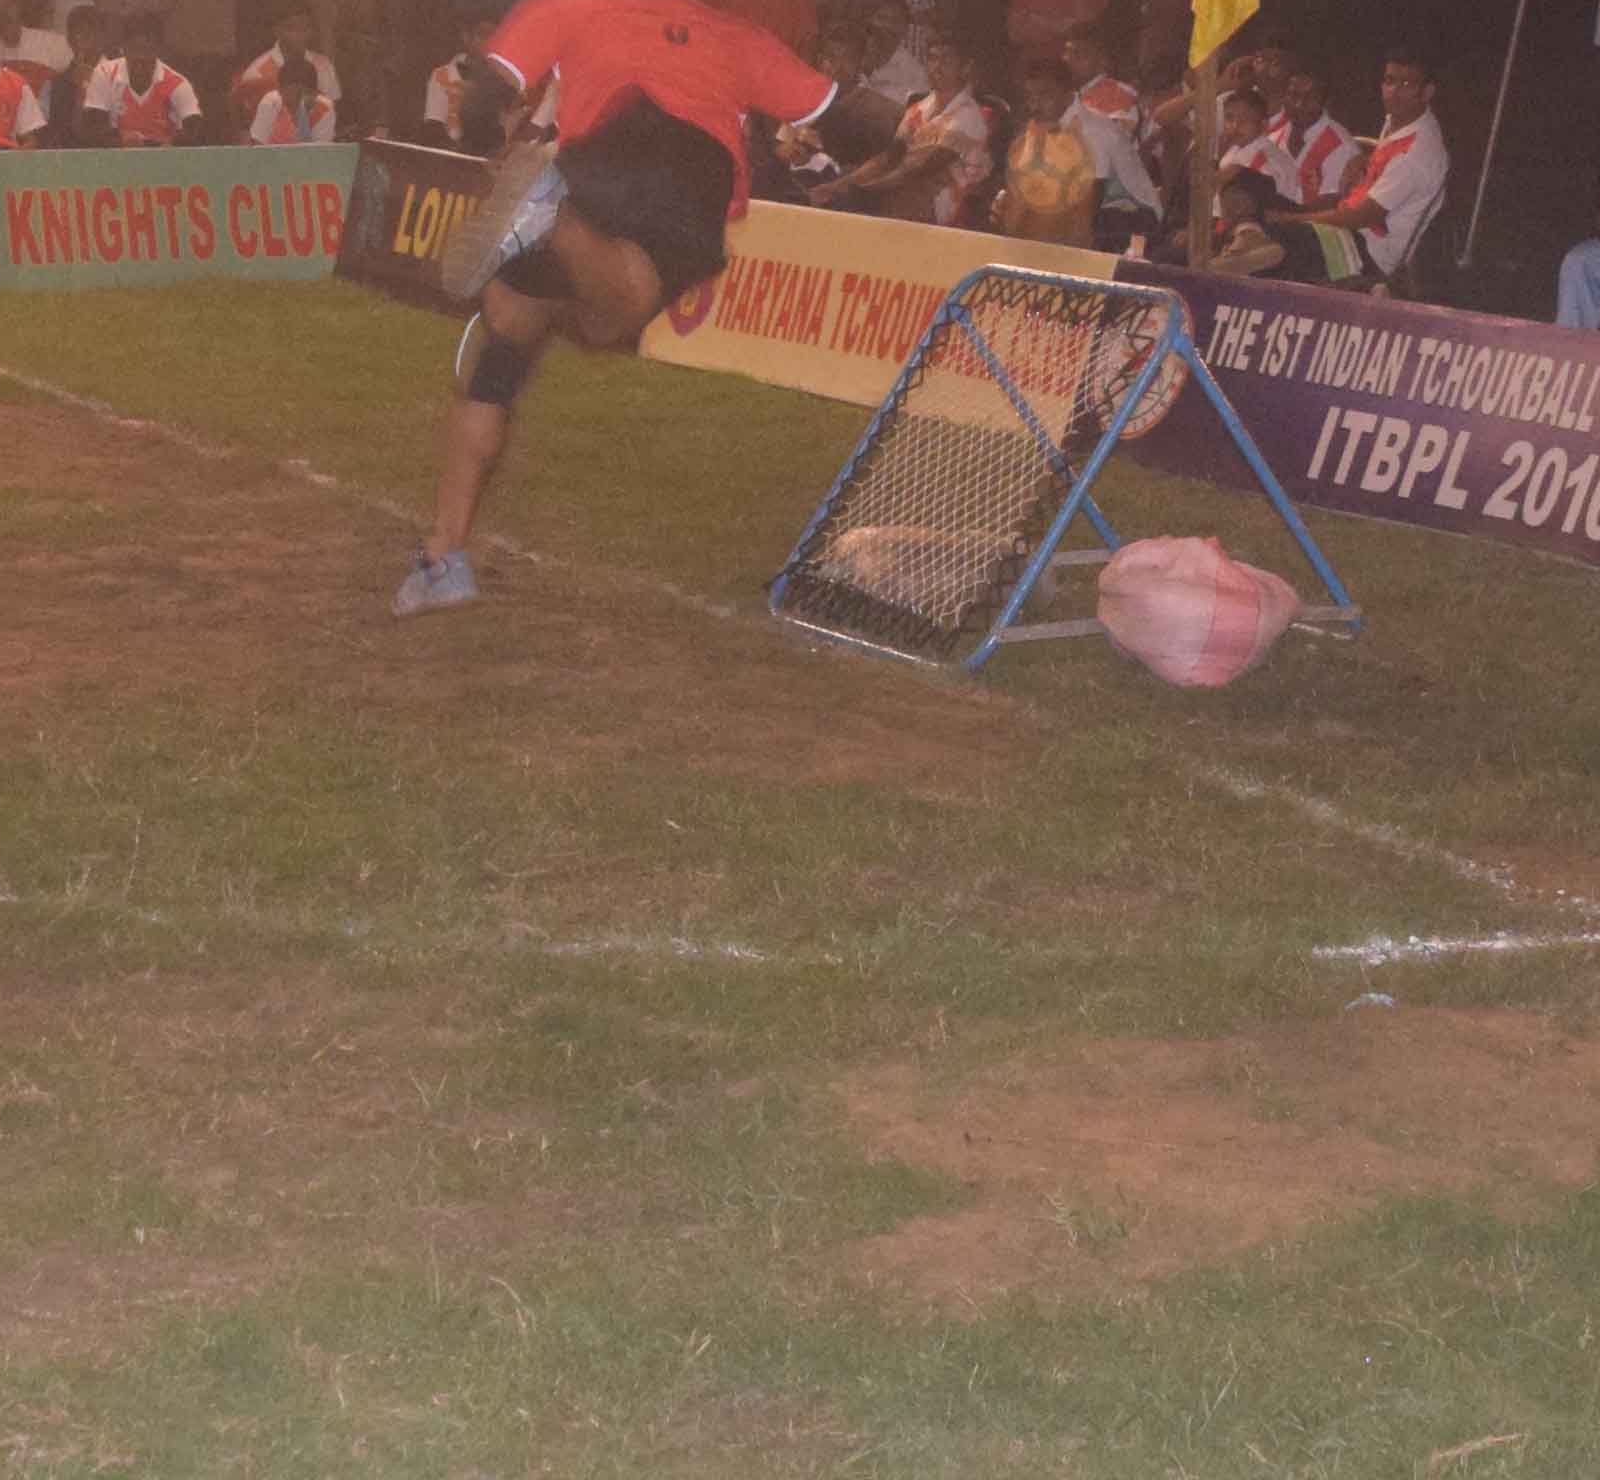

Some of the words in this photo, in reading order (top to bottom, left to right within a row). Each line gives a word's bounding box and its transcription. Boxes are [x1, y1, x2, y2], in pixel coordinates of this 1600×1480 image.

[6, 185, 217, 266] KNIGHTS
[228, 182, 345, 260] CLUB
[714, 254, 834, 347] HARYANA
[1206, 304, 1265, 370] THE
[1259, 313, 1315, 379] 1ST
[1305, 321, 1413, 397] INDIAN
[1307, 406, 1472, 510] ITBPL
